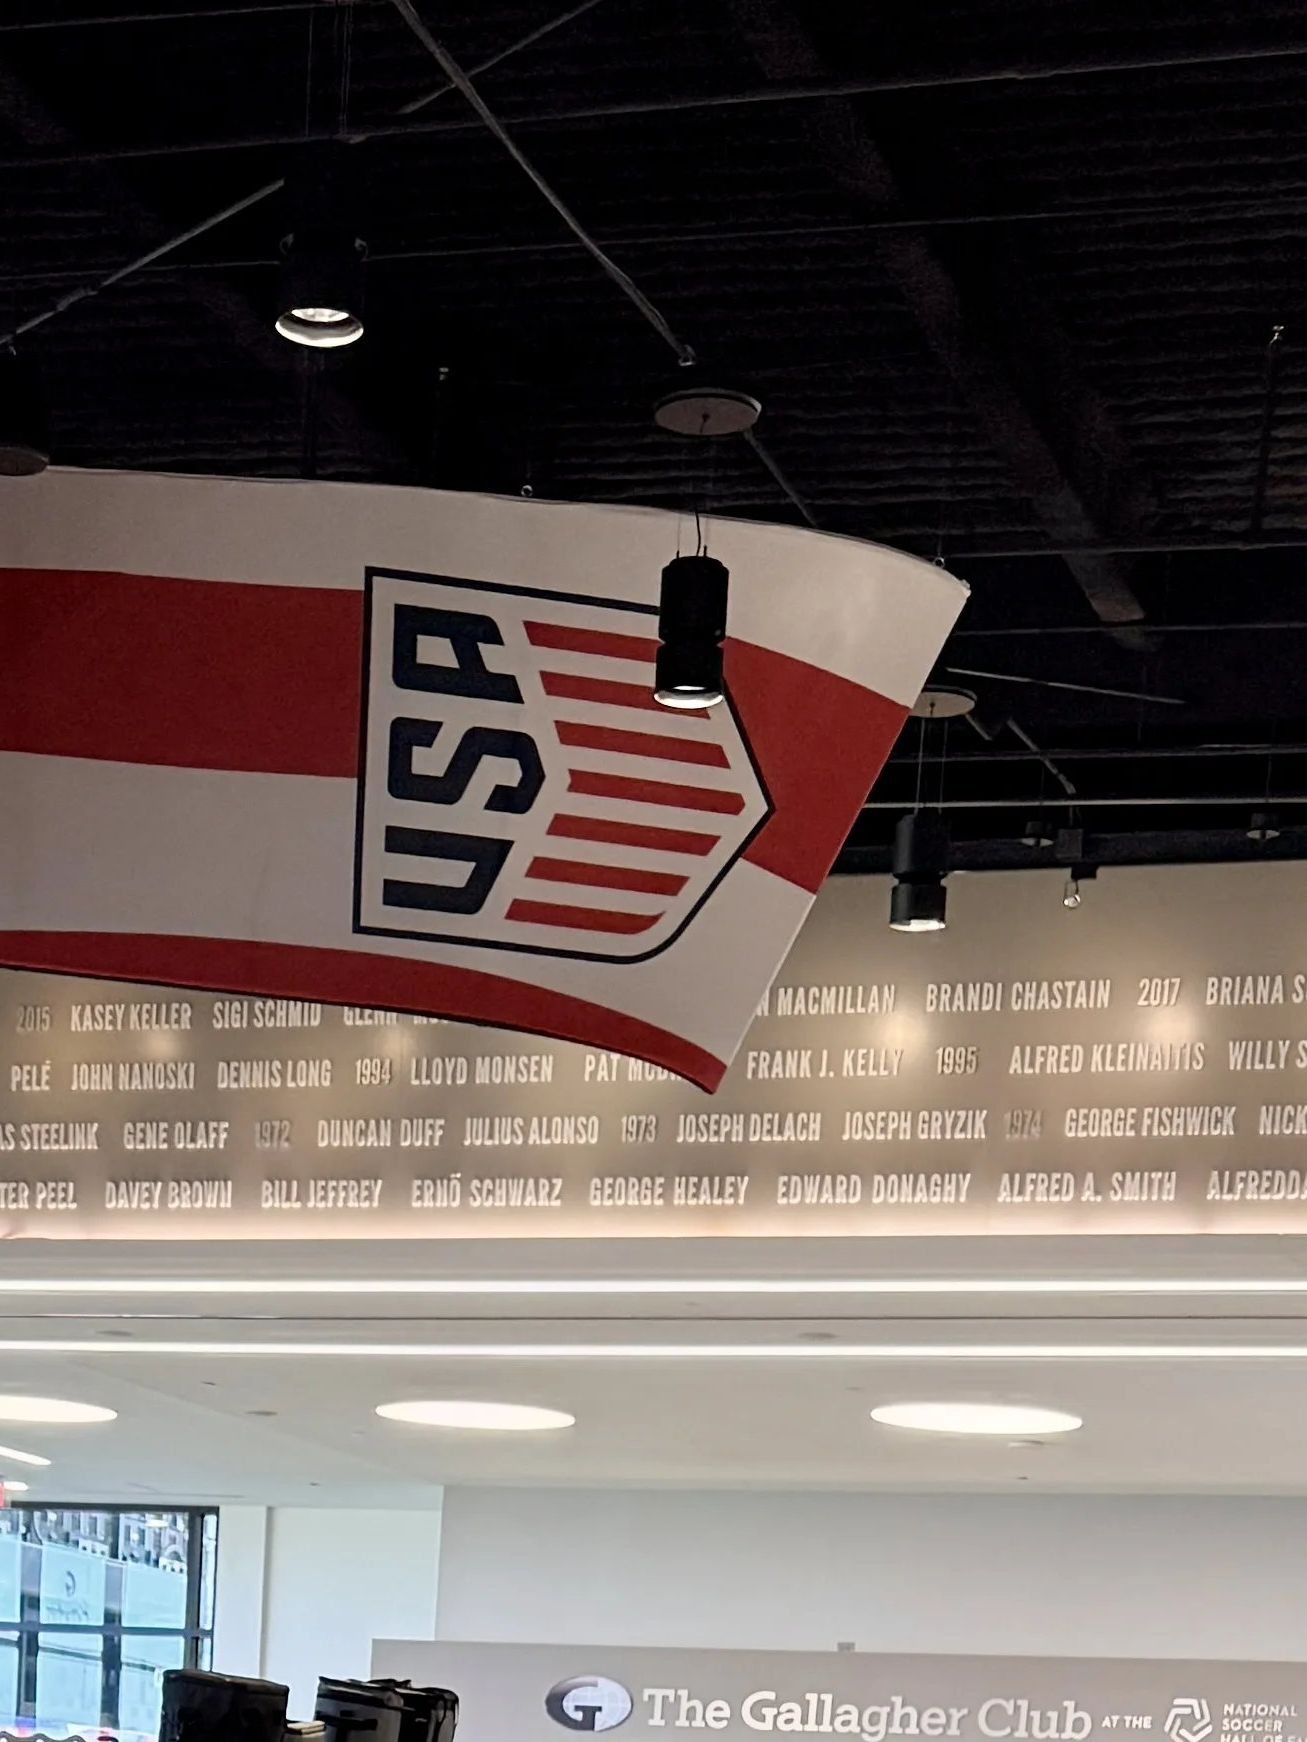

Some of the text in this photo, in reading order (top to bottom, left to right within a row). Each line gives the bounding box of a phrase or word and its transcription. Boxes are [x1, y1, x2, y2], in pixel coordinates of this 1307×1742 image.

[383, 603, 546, 915] USA
[15, 1006, 51, 1034] 2015
[71, 1004, 126, 1032] KASEY
[130, 1003, 192, 1031] KELLER
[212, 1002, 248, 1029] SIGI
[253, 1000, 322, 1028] SCHMID
[777, 985, 895, 1016] MACMILLAN
[926, 983, 1003, 1012] BRANDI
[1011, 980, 1111, 1011] CHASTAIN
[1138, 978, 1181, 1007] 2017
[1206, 975, 1284, 1006] BRIANA
[11, 1060, 52, 1092] PELÉ
[71, 1063, 113, 1091] JOHN
[118, 1062, 195, 1091] NANOSKI
[217, 1060, 282, 1089] DENNIS
[287, 1059, 332, 1088] LONG
[355, 1058, 392, 1086] 1994
[411, 1057, 467, 1086] LLOYD
[475, 1055, 554, 1085] MONSEN
[584, 1054, 621, 1082] PAT
[747, 1050, 812, 1079] FRANK
[819, 1050, 834, 1078] J.
[843, 1048, 904, 1077] KELLY
[936, 1047, 978, 1074] 1995
[1009, 1045, 1083, 1074] ALFRED
[1229, 1040, 1290, 1070] WILLY
[20, 1123, 99, 1151] STEELINK
[123, 1122, 168, 1150] GENE
[174, 1121, 229, 1149] OLAFF
[254, 1120, 291, 1149] 1972
[317, 1119, 391, 1148] DUNCAN
[399, 1118, 445, 1147] DUFF
[463, 1117, 524, 1146] JULIUS
[528, 1115, 600, 1145] ALONSO
[621, 1115, 658, 1143] 1973
[676, 1113, 744, 1143] JOSEPH
[748, 1112, 822, 1142] DELACH
[842, 1111, 912, 1141] JOSEPH
[917, 1110, 988, 1140] GRYZIK
[1003, 1109, 1042, 1139] 1974
[1064, 1107, 1137, 1138] GEORGE
[1141, 1106, 1237, 1136] FISHWICK
[1259, 1105, 1307, 1135] NICK
[35, 1182, 78, 1210] PEEL
[105, 1181, 163, 1210] DAVEY
[168, 1181, 232, 1209] BROWN
[261, 1180, 301, 1209] BILL
[307, 1179, 383, 1209] JEFFREY
[469, 1178, 563, 1208] SCHWARZ
[589, 1177, 665, 1207] GEORGE
[673, 1176, 749, 1205] HEALEY
[777, 1174, 862, 1204] EDWARD
[871, 1173, 972, 1204] DONAGHY
[997, 1172, 1075, 1203] ALFRED
[1081, 1172, 1102, 1202] A.
[1109, 1171, 1177, 1202] SMITH
[643, 1688, 1152, 1742] The Gallagher Club AT THE
[1222, 1718, 1282, 1733] SOCCER
[1223, 1703, 1298, 1718] NATIONAL
